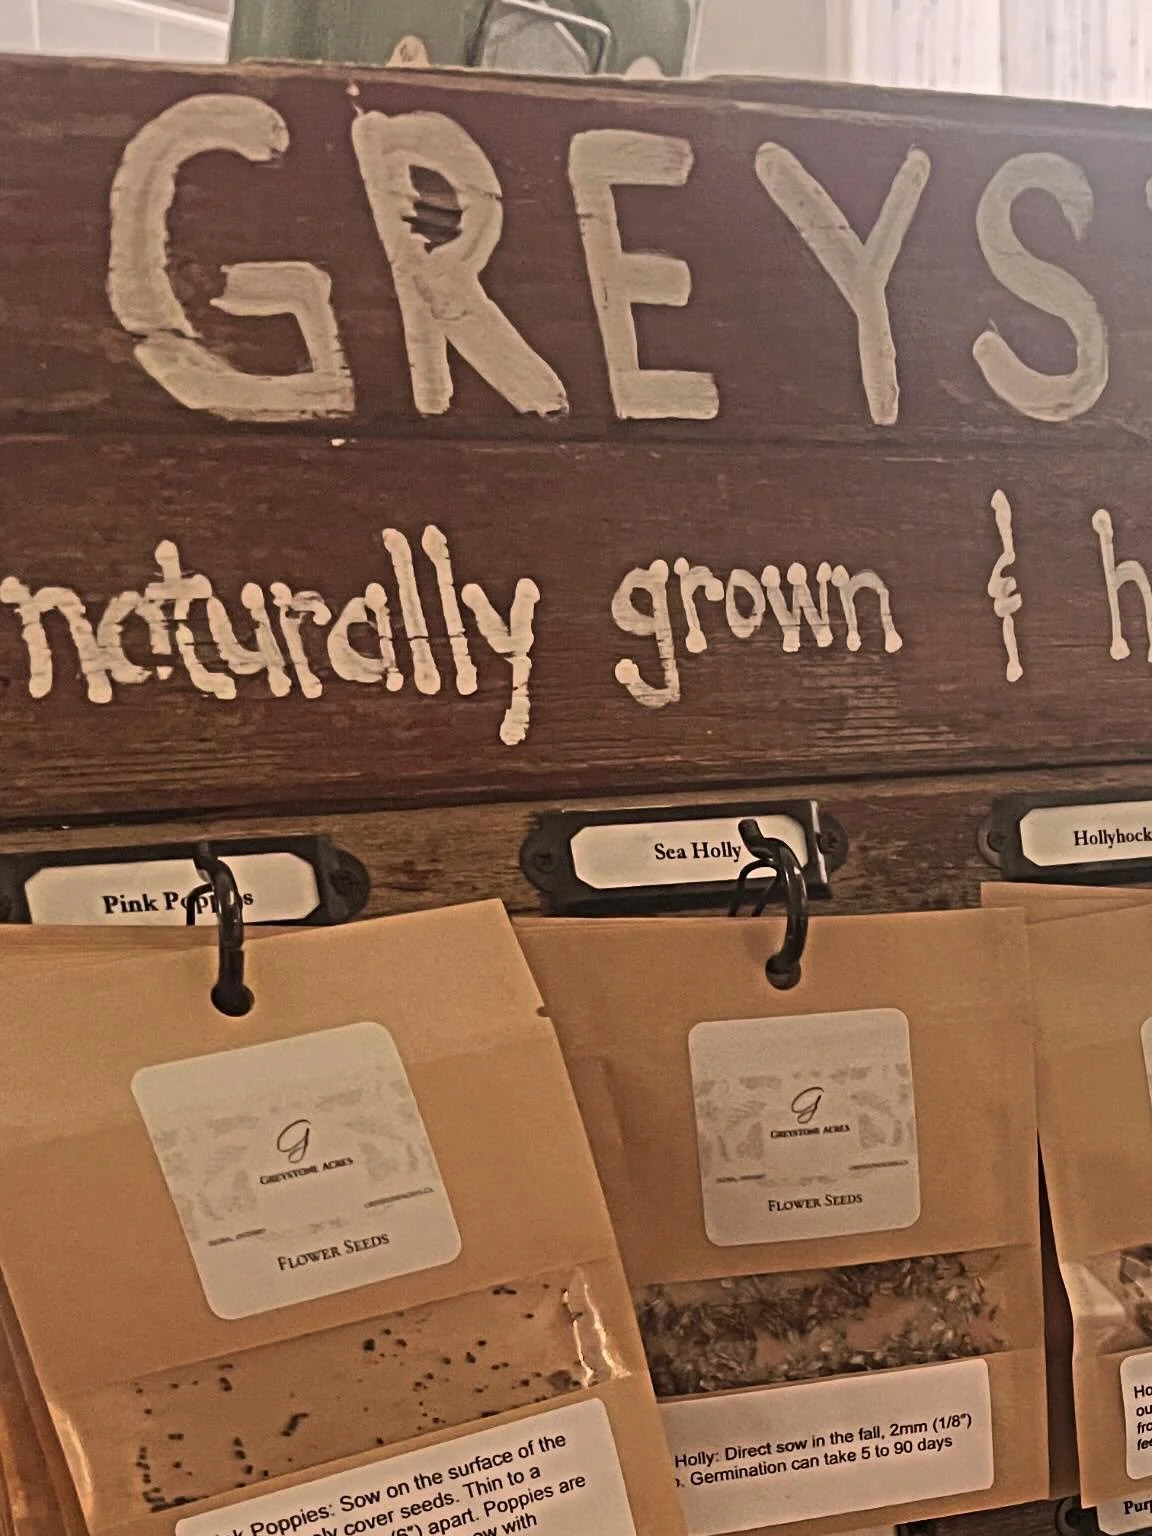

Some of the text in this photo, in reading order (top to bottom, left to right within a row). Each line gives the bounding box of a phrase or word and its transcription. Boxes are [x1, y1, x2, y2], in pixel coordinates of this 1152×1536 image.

[0, 526, 540, 744] naturally
[611, 558, 903, 707] grown
[991, 489, 1022, 681] &
[654, 841, 742, 862] Sea Holly
[102, 893, 159, 914] Pink
[674, 1450, 719, 1468] Holly:
[724, 1441, 772, 1461] Direct
[775, 1438, 808, 1453] sow
[811, 1434, 825, 1448] in
[828, 1431, 854, 1445] the
[889, 1421, 928, 1436] 2mm
[689, 1436, 953, 1486] Germination can take 5 to 90 days
[339, 1489, 380, 1512] Sow
[385, 1481, 410, 1498] on
[413, 1471, 443, 1490] the
[447, 1450, 513, 1480] surface
[517, 1439, 534, 1459] of
[537, 1434, 566, 1452] the
[343, 1509, 394, 1536] cover
[399, 1491, 460, 1519] seeds.
[461, 1476, 503, 1498] Thin
[506, 1471, 524, 1486] to
[528, 1465, 541, 1479] a
[427, 1507, 479, 1535] apart.
[482, 1485, 554, 1517] Poppies
[558, 1475, 586, 1494] are
[500, 1512, 537, 1535] with
